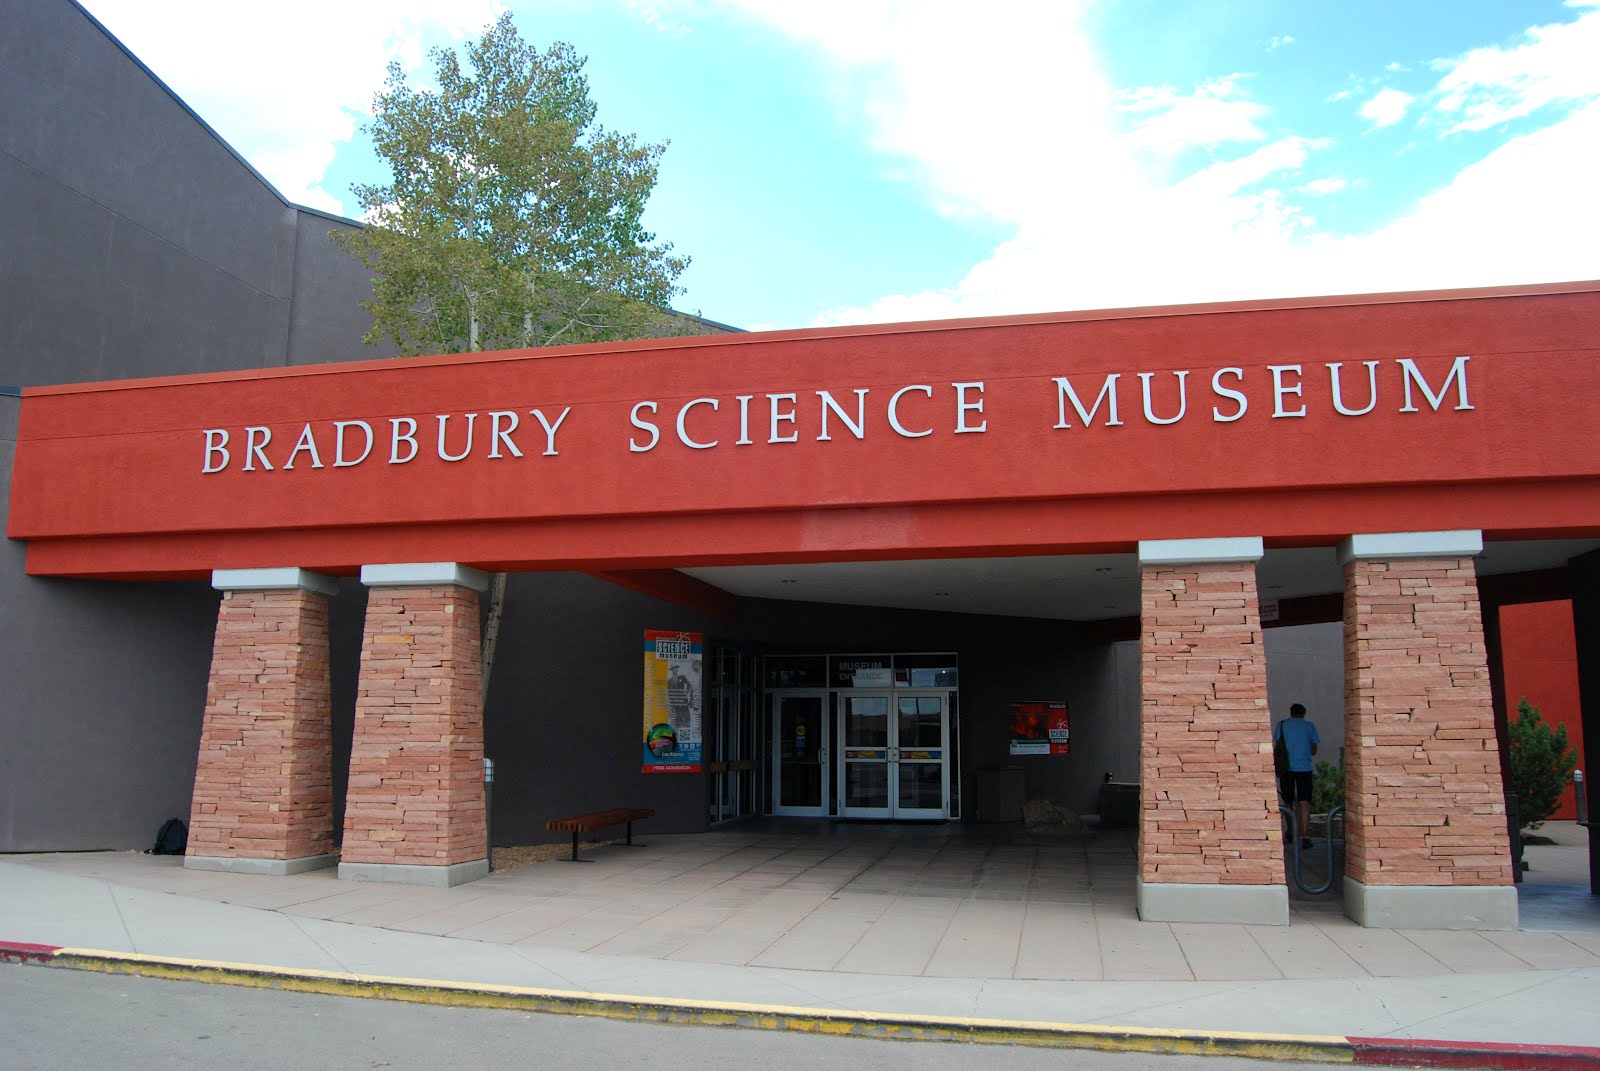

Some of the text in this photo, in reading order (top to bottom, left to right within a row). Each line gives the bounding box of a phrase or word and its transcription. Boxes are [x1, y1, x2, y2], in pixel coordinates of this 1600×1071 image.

[201, 355, 1475, 474] BRADBURY SCIENCE MUSEUM
[658, 642, 690, 653] SCIENCE
[839, 661, 883, 671] MUSEUM
[839, 671, 884, 681] ENTRANCE
